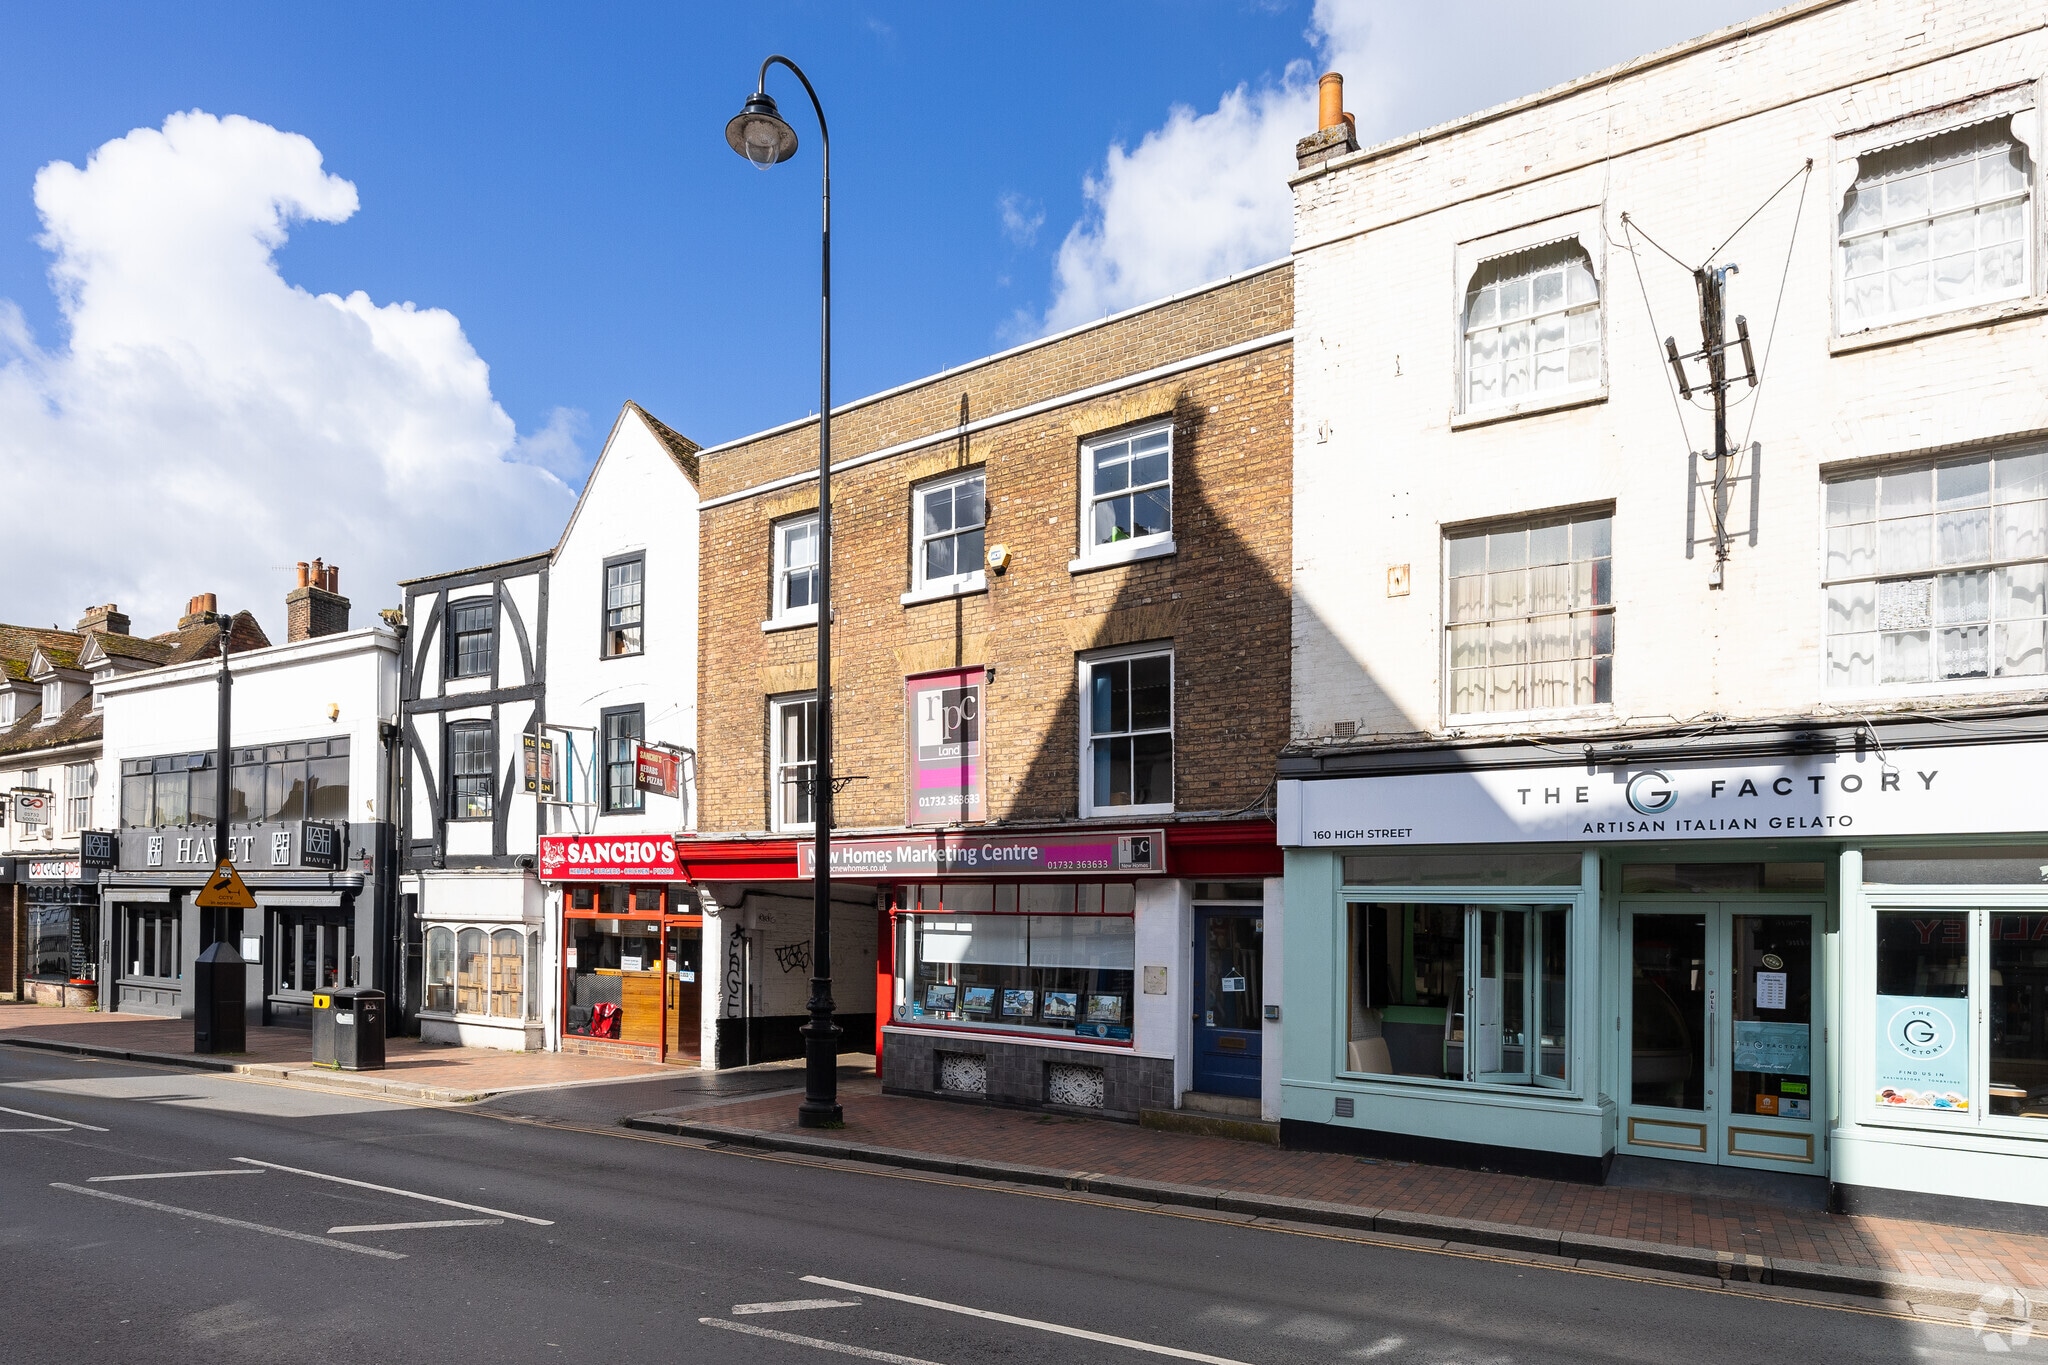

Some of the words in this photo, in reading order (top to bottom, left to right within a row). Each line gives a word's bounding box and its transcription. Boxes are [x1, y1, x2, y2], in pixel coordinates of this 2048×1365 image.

[926, 695, 976, 740] rpc
[524, 738, 551, 749] KEAB
[640, 750, 662, 763] SANCHO'S
[939, 745, 960, 757] Land
[640, 763, 659, 775] KEBABS
[528, 781, 551, 791] OEN
[639, 772, 646, 783] &
[646, 775, 663, 787] PIZZAS
[1517, 786, 1589, 805] THE
[1625, 768, 1679, 816] G
[1711, 770, 1939, 799] FACTORY
[919, 796, 946, 807] 01732
[948, 793, 980, 806] 363633
[1582, 821, 1665, 833] ARTISAN
[1676, 818, 1757, 831] ITALIAN
[1769, 815, 1853, 829] GELATO
[1313, 830, 1331, 840] 160
[1334, 829, 1364, 839] HIGH
[1367, 828, 1413, 838] STREET
[567, 841, 676, 864] SANCHO'S
[808, 848, 839, 864] Nw
[843, 847, 893, 864] Homes
[896, 844, 977, 865] Marketing
[982, 843, 1038, 861] Centre
[1123, 839, 1149, 861] rpc
[305, 856, 331, 865] HAVET
[1047, 861, 1073, 869] 01732
[1076, 860, 1108, 869] 363633
[1899, 1042, 1944, 1055] FACTORY
